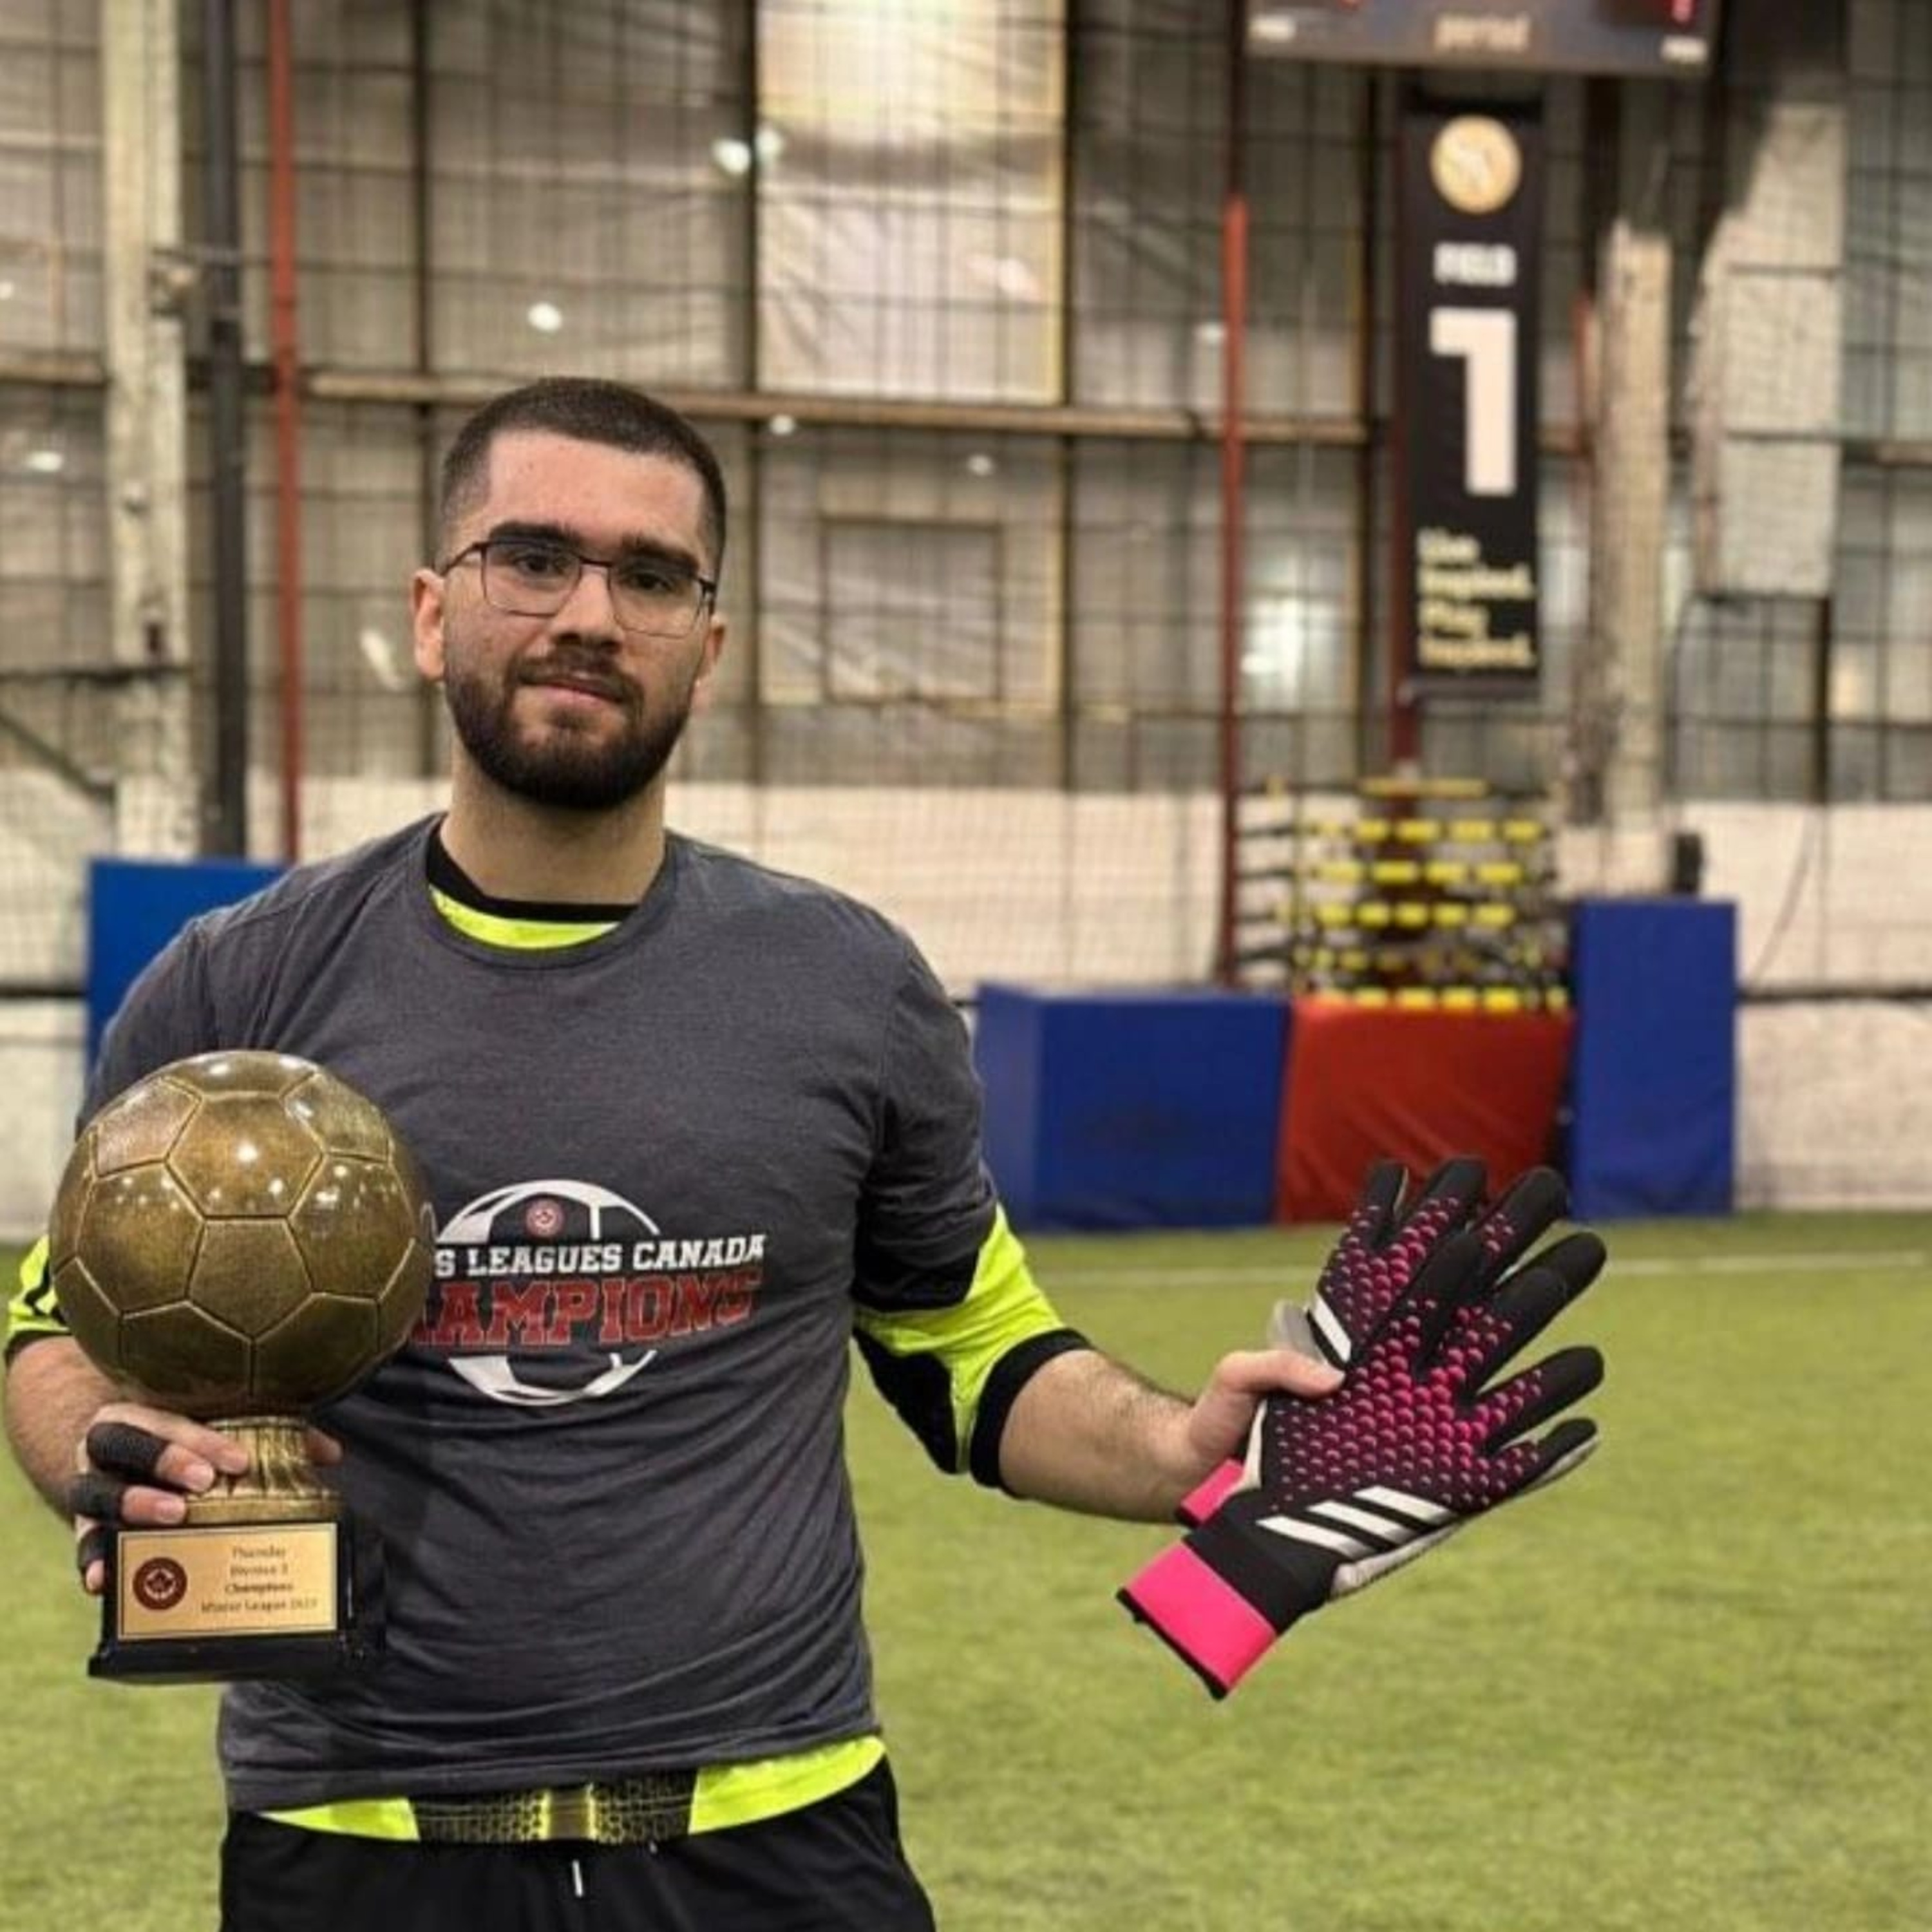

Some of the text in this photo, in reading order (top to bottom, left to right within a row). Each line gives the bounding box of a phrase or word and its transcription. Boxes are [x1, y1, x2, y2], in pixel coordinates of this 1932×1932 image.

[1429, 307, 1517, 497] 1
[467, 1242, 621, 1276] LEAGUES
[632, 1234, 766, 1269] CANADA
[413, 1267, 762, 1345] AMPIONS
